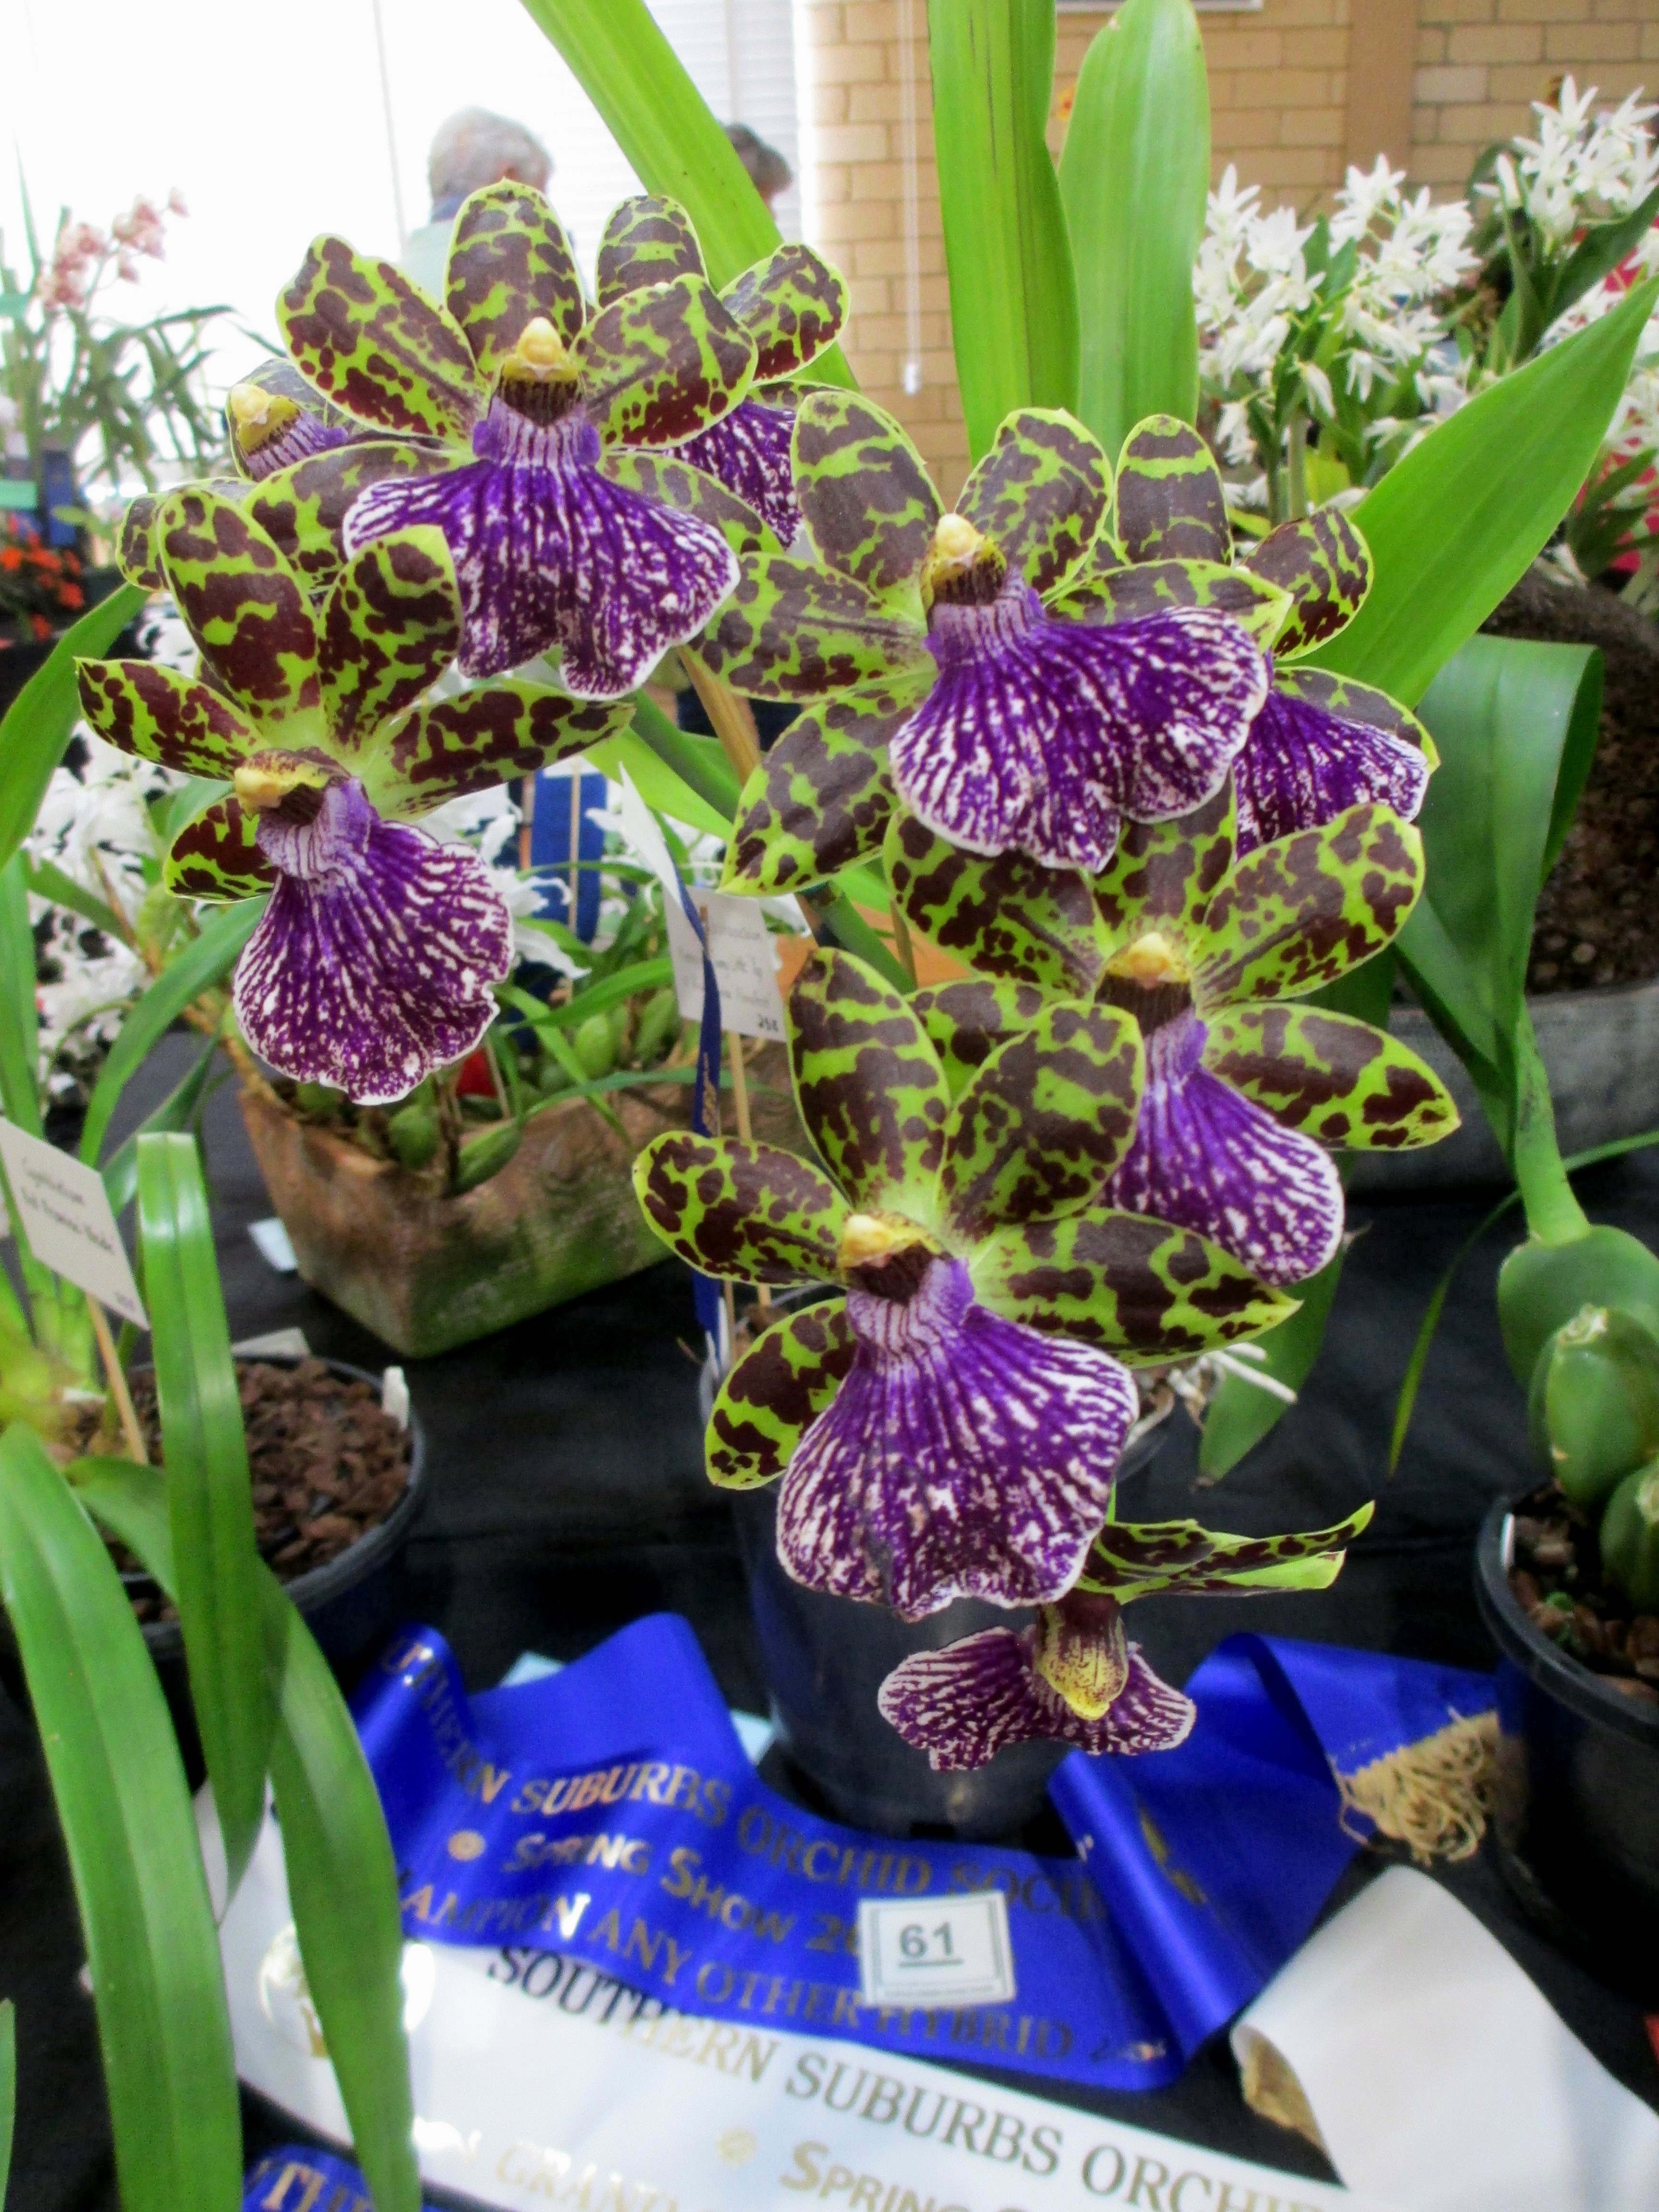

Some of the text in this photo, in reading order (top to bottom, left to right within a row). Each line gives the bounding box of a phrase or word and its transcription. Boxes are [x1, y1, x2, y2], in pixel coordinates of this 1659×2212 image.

[511, 1761, 730, 1827] SUBURBS
[738, 1806, 931, 1894] ORCHID
[661, 1847, 795, 1942] SHOW
[899, 1922, 953, 1959] 61
[588, 1908, 692, 1985] ANY
[696, 1961, 861, 2028] OTHER
[875, 2000, 1073, 2060] HYBRID
[486, 1945, 781, 2083] SOUTHERN
[785, 2052, 1063, 2176] SUBURBS
[780, 2140, 971, 2212] SPRIN
